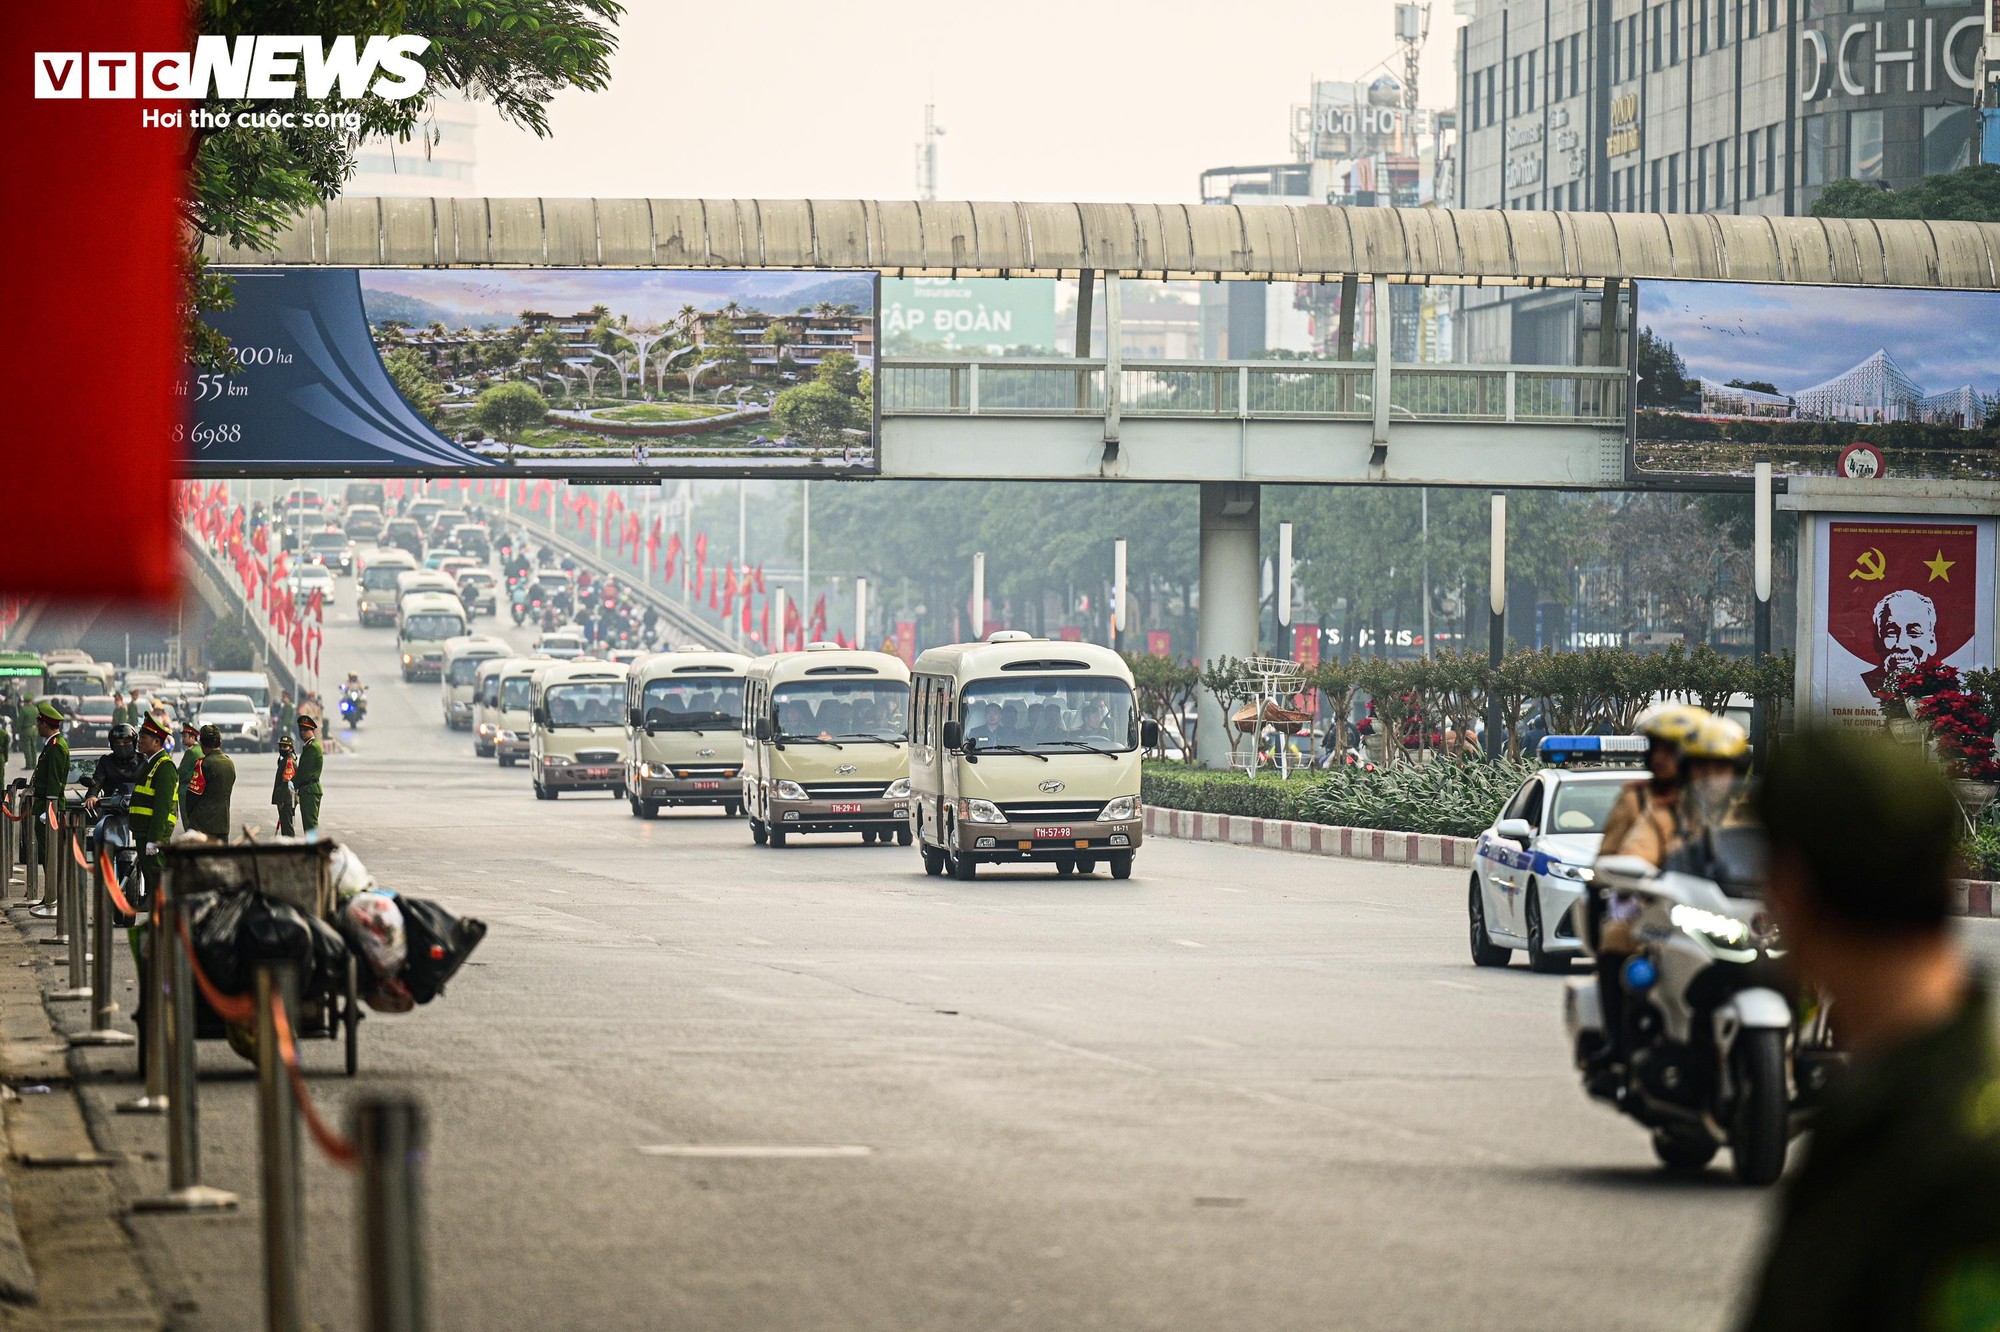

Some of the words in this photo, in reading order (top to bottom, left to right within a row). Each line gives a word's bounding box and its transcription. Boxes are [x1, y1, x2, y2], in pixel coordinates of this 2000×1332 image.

[934, 302, 1012, 332] ĐOÀN
[226, 346, 274, 365] 200
[276, 348, 293, 364] ha
[194, 373, 225, 402] 55
[227, 380, 249, 396] km
[191, 421, 242, 451] 6988
[1832, 706, 1853, 716] TOÀN
[1854, 706, 1879, 717] ĐẢNG,
[832, 804, 861, 812] TH-29-14
[1036, 827, 1071, 837] TH-57-98
